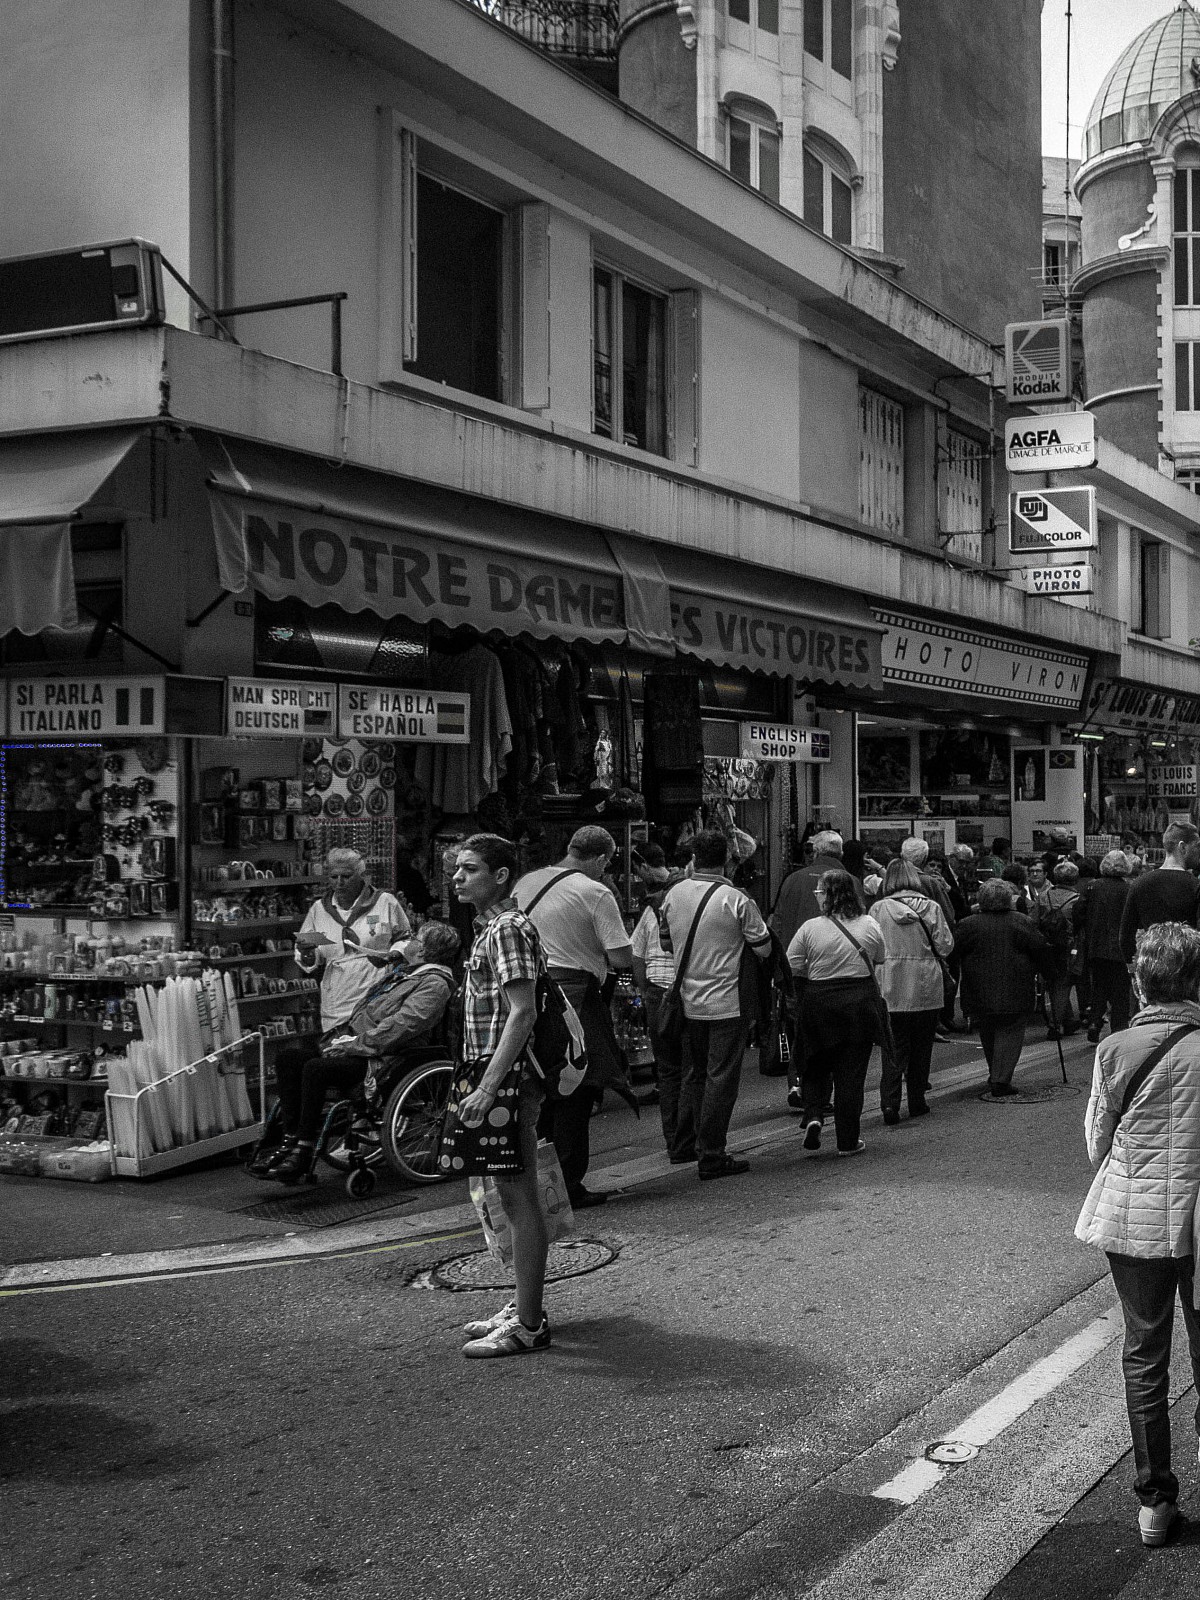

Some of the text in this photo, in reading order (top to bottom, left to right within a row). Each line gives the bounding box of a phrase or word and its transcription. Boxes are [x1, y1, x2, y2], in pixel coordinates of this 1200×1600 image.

[1013, 372, 1061, 382] PRODUITS
[1013, 380, 1061, 396] Kodak
[1009, 429, 1061, 449] AGFA
[1041, 447, 1052, 455] DE
[1054, 443, 1091, 455] MARQUE
[1019, 531, 1082, 544] FUJICOLOR
[246, 514, 614, 629] NOTRE DAME
[1033, 569, 1082, 580] PHOTO
[1034, 580, 1081, 592] VIRON
[670, 603, 870, 674] ES VICTOIRES
[894, 636, 1080, 693] HOTO VIRON
[16, 683, 103, 705] SI PARLA
[232, 686, 264, 704] MAN
[349, 691, 436, 715] SE HABLA
[1108, 685, 1151, 716] LOUIS
[20, 709, 101, 731] ITALIANO
[235, 710, 299, 729] DEUTSCH
[353, 711, 427, 737] ESPAÑOL
[750, 726, 807, 743] ENGLISH
[761, 743, 796, 758] SHOP
[1164, 767, 1192, 780] LOUIS
[1148, 782, 1196, 795] DE FRANCE
